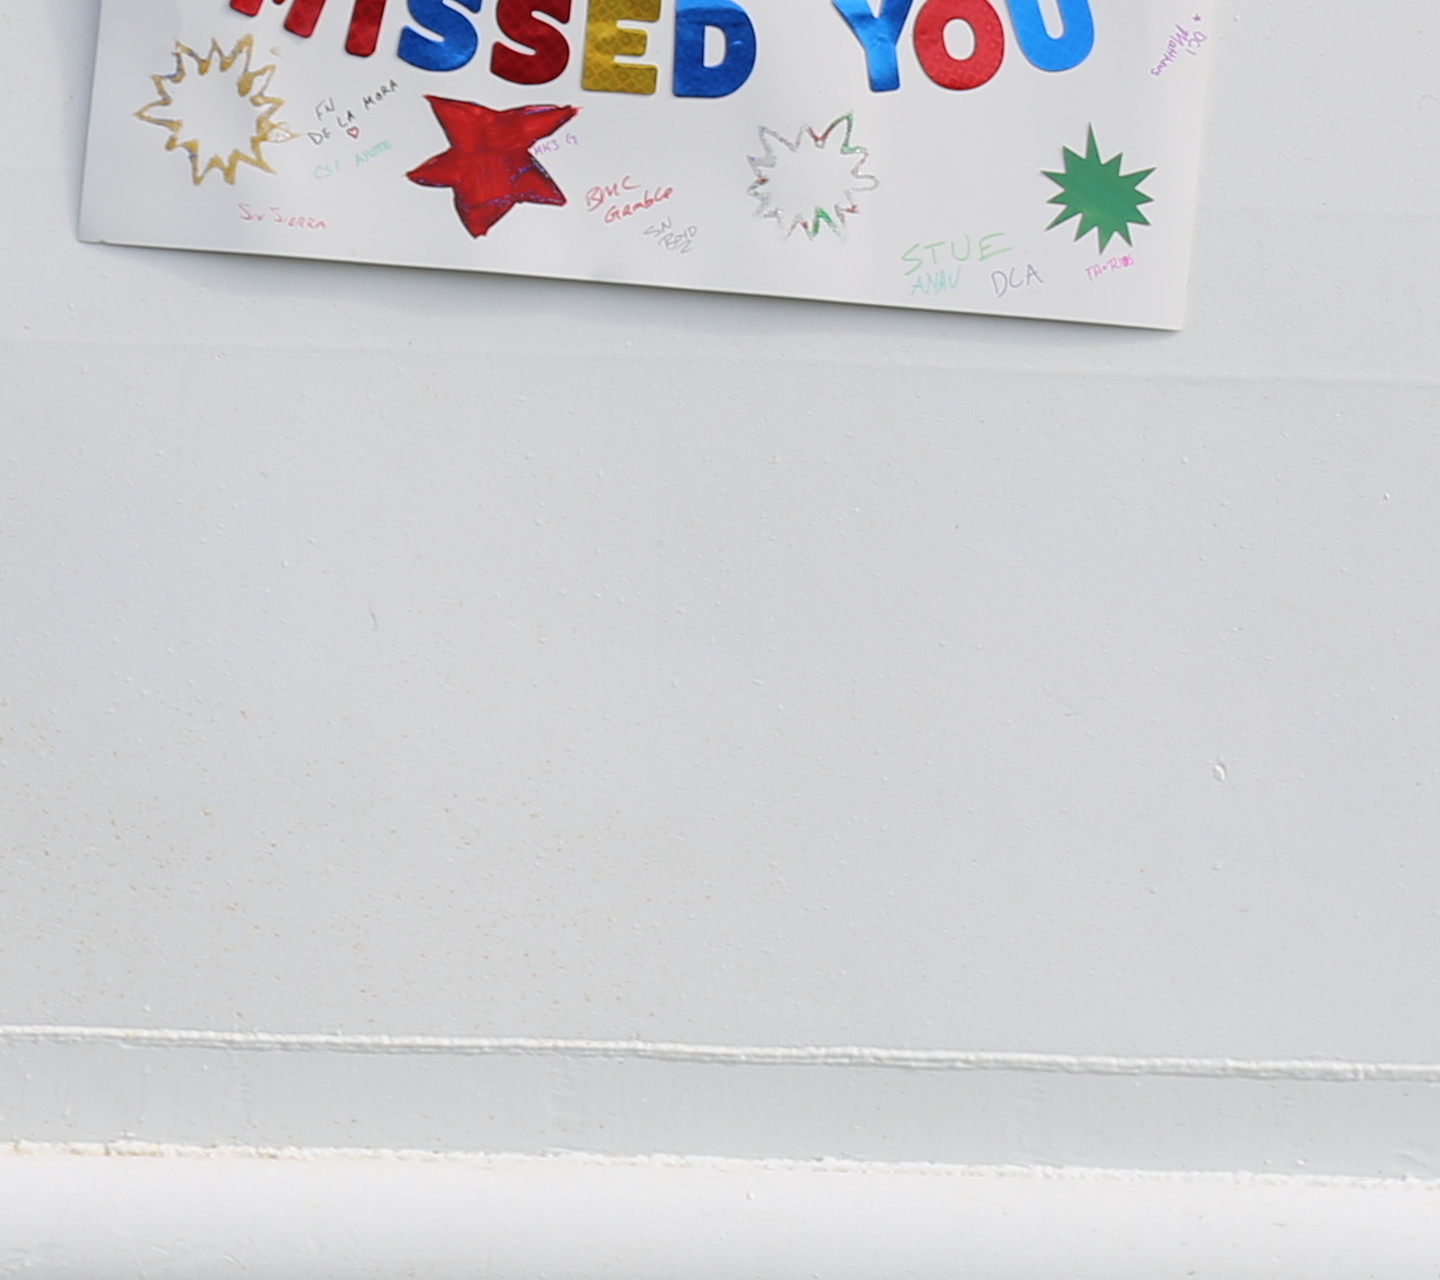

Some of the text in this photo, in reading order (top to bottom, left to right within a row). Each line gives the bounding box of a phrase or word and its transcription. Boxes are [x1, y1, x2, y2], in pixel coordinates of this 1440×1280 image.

[306, 78, 399, 146] DE LA MORA
